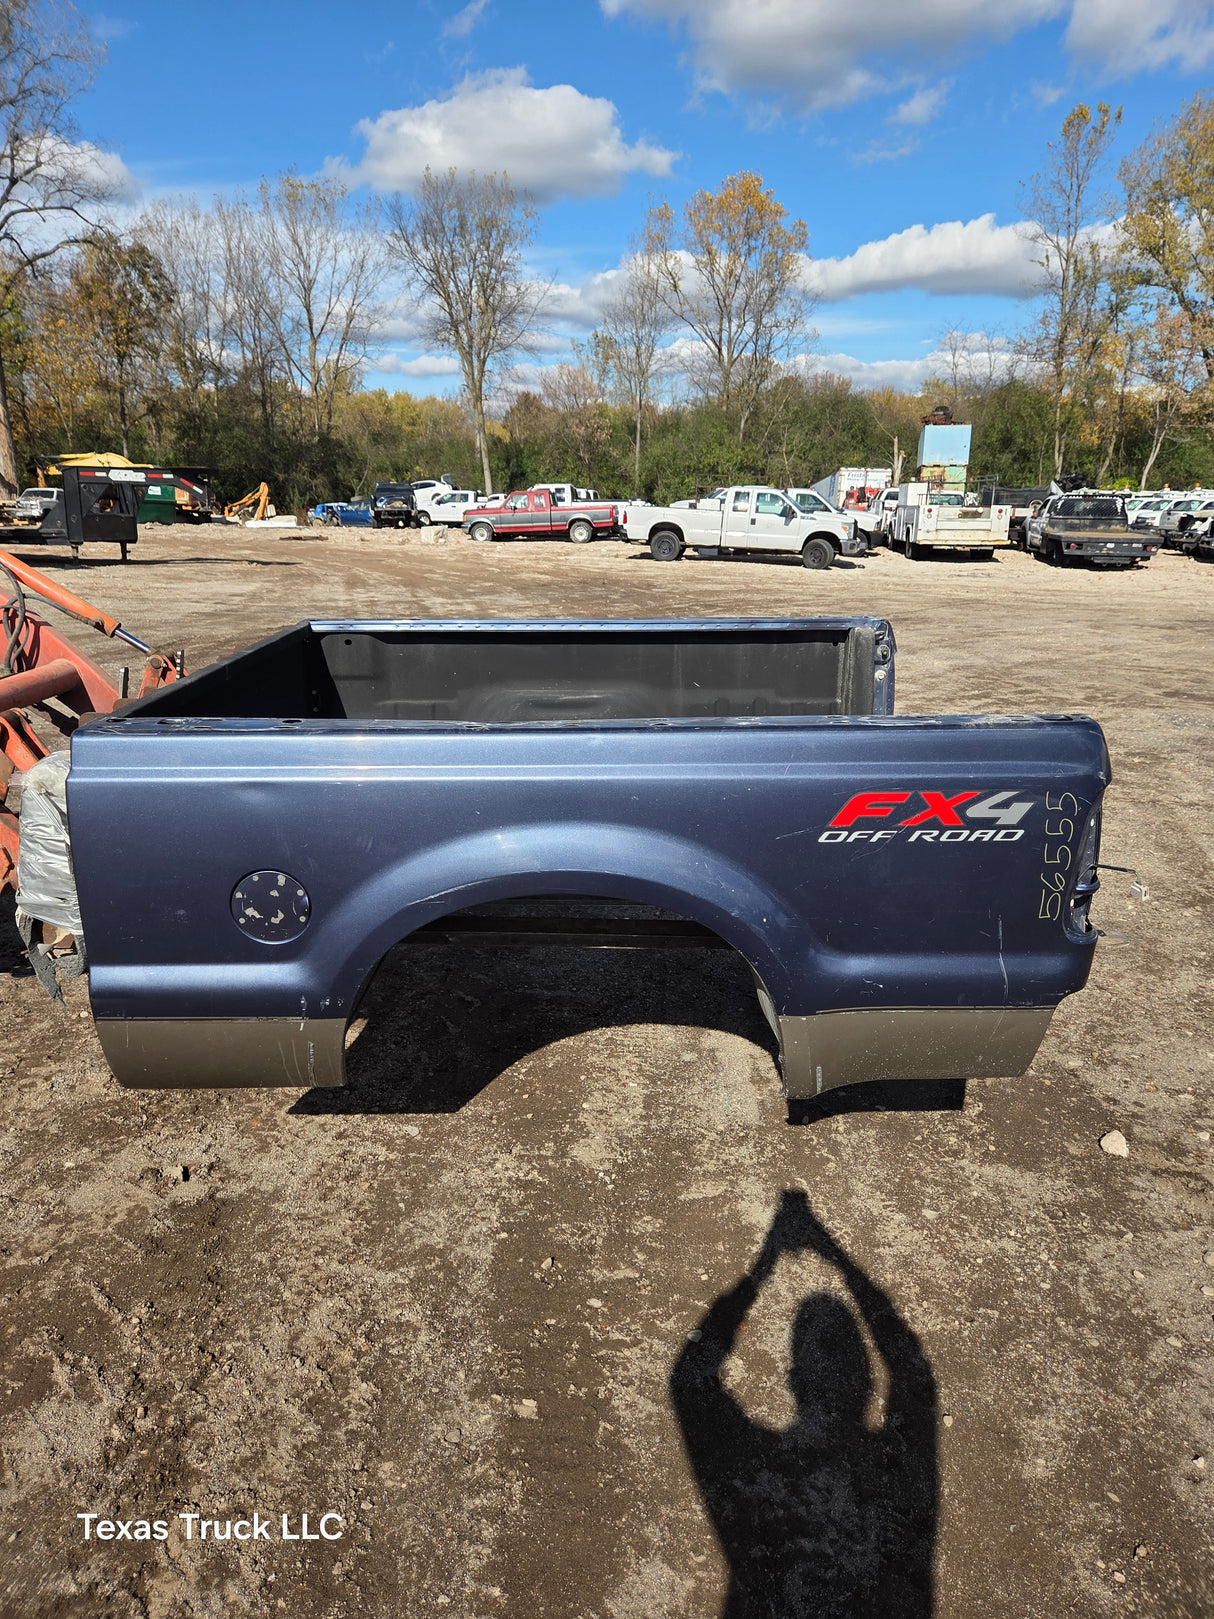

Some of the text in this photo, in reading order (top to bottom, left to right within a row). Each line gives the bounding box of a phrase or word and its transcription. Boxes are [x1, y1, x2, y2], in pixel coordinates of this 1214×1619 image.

[828, 791, 1035, 827] FX4
[818, 829, 1025, 843] OFF ROAD
[1038, 791, 1078, 921] 56555
